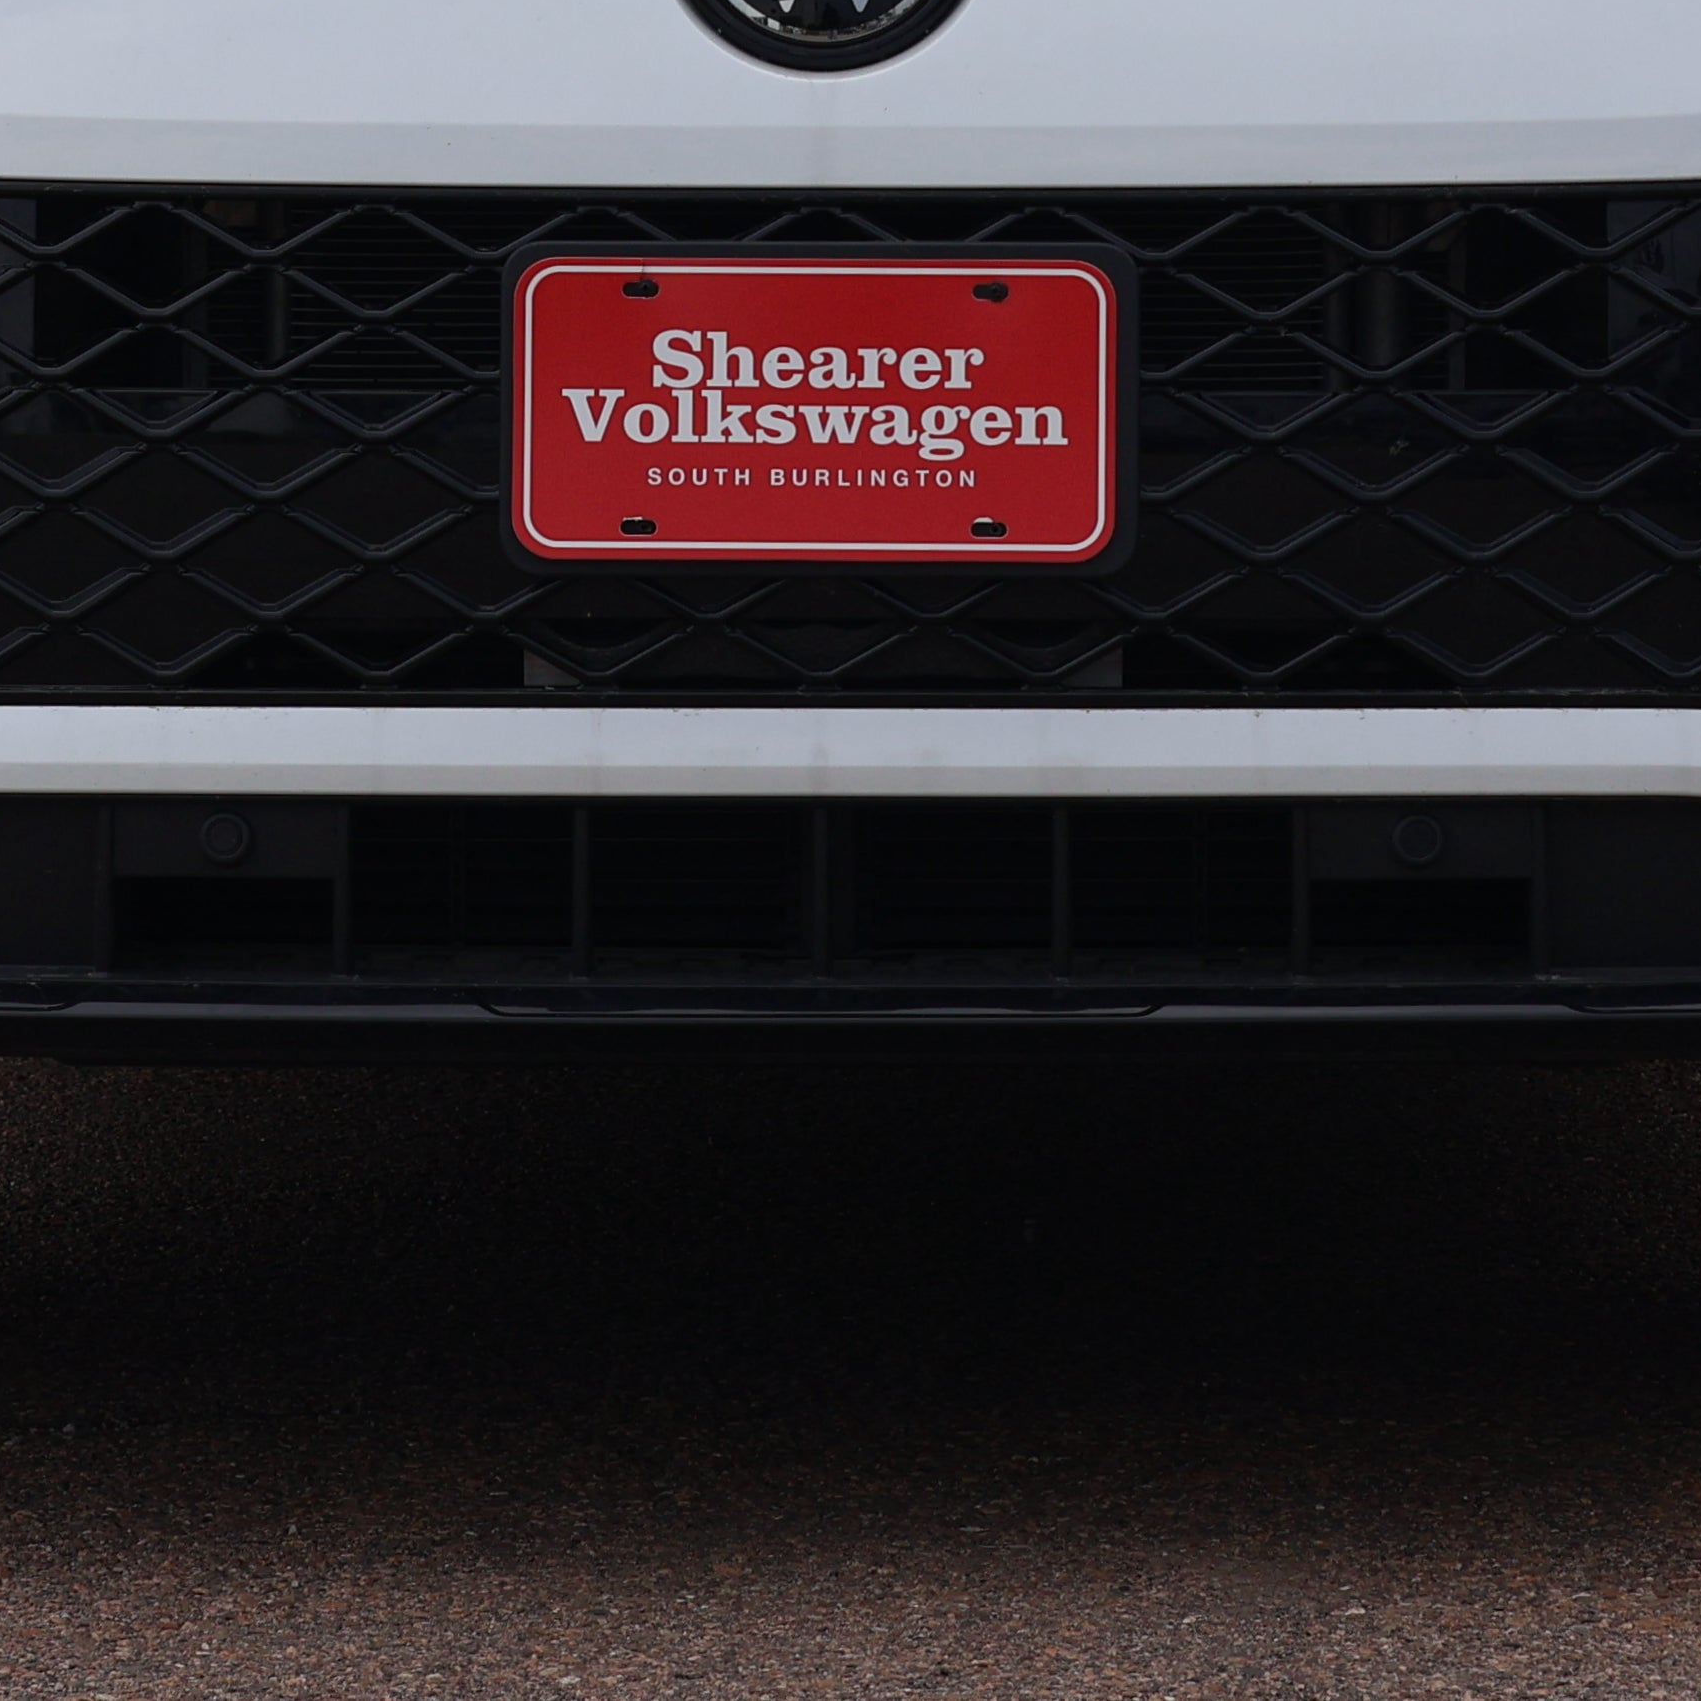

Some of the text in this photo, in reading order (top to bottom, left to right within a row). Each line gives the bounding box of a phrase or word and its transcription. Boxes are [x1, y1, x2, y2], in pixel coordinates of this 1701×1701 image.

[652, 329, 985, 390] Shearer
[561, 387, 1069, 462] Volkswagen
[646, 467, 978, 489] SOUTH BURLINGTON
